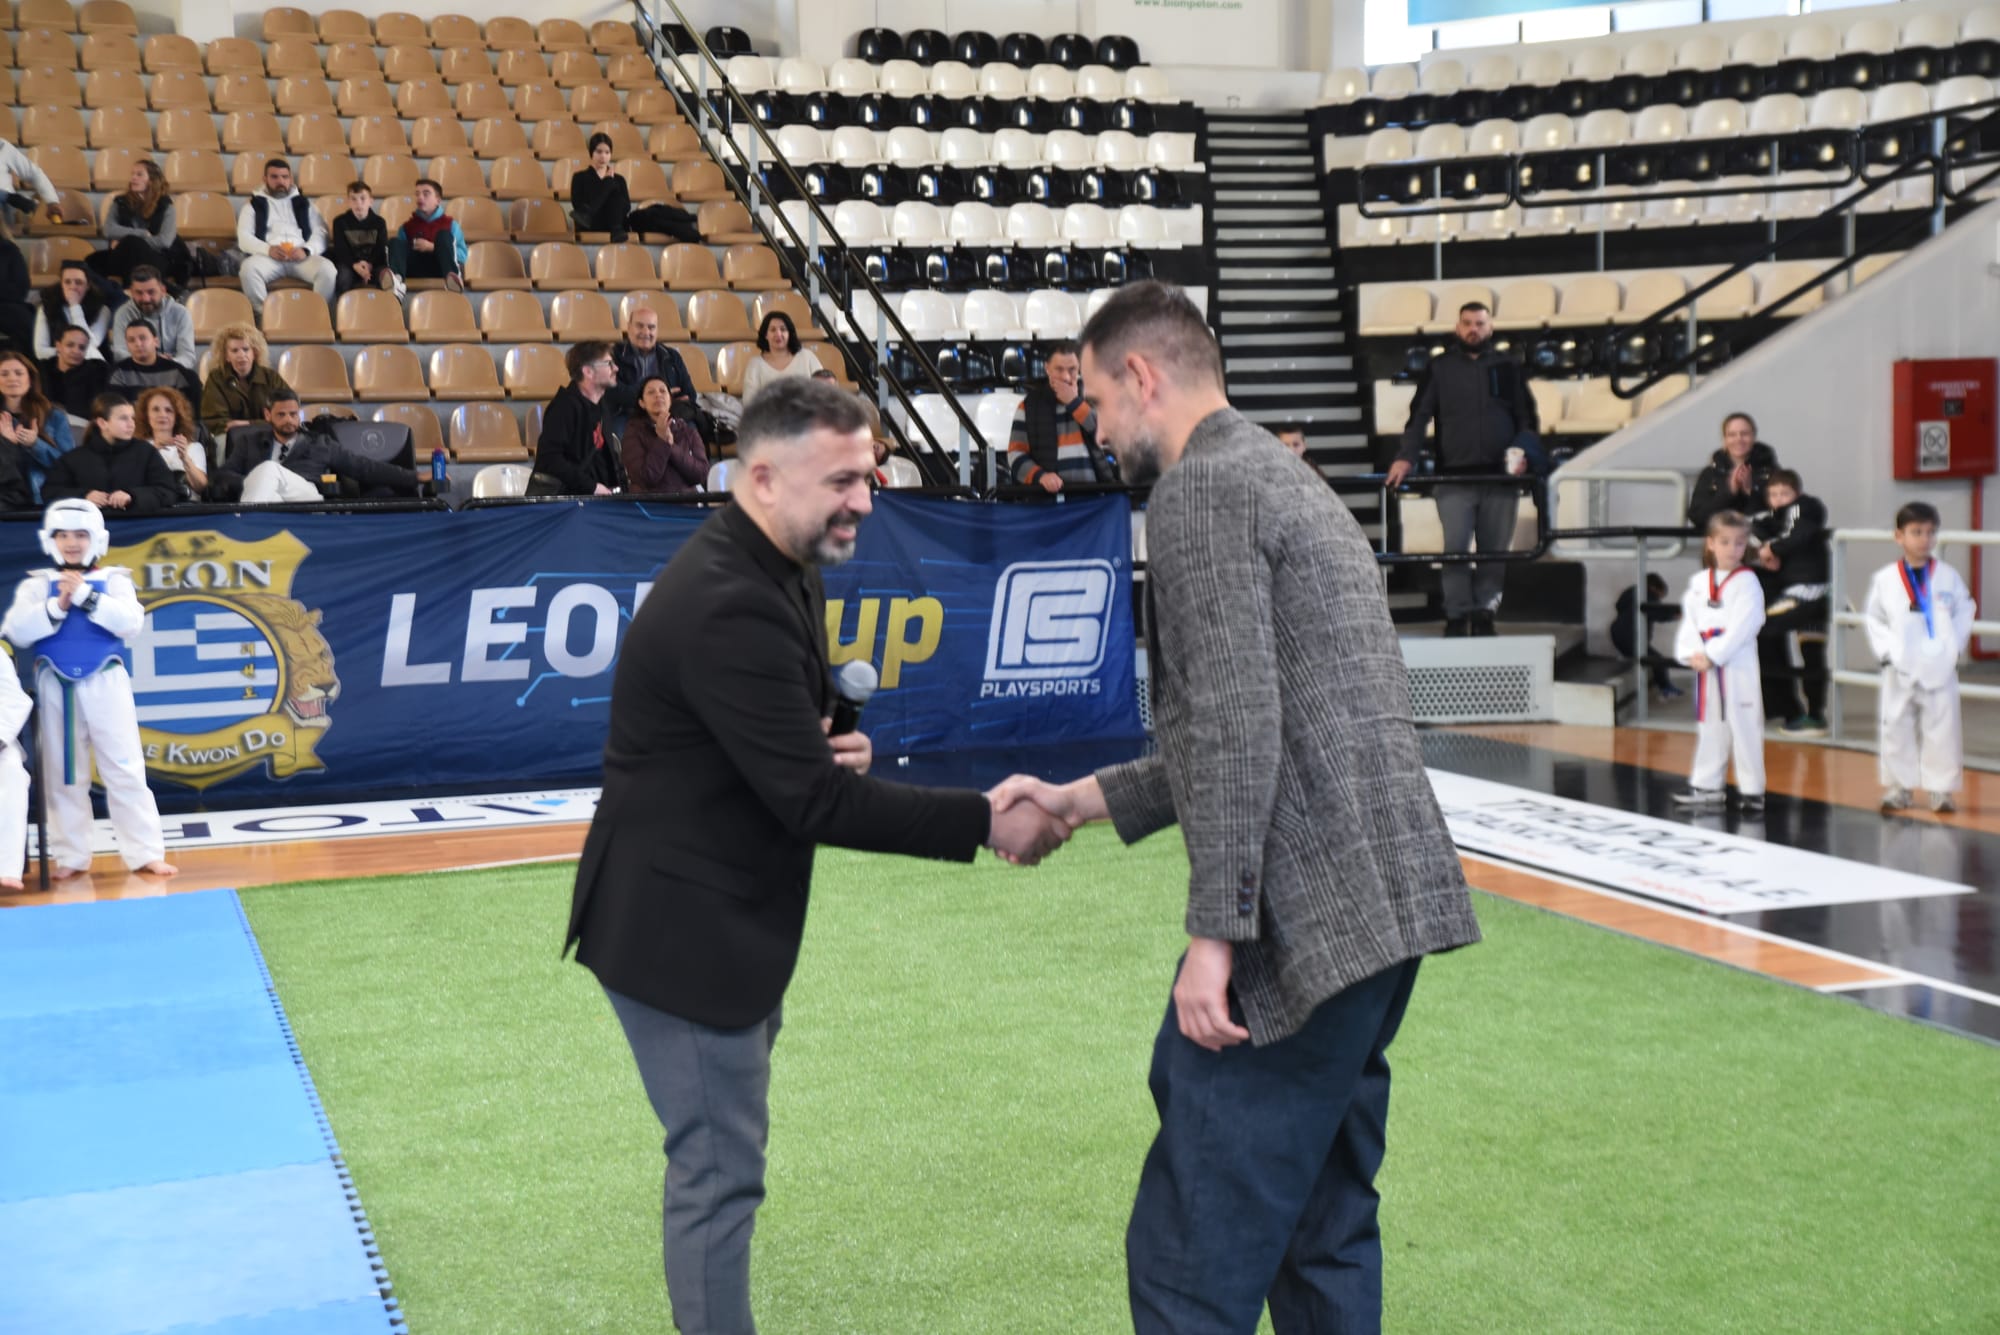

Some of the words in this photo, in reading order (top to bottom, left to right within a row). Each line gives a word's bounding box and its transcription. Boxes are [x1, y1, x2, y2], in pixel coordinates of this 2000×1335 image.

[135, 559, 273, 591] ΕΩΝ
[380, 581, 656, 688] LEO
[980, 678, 1101, 698] PLAYSPORTS
